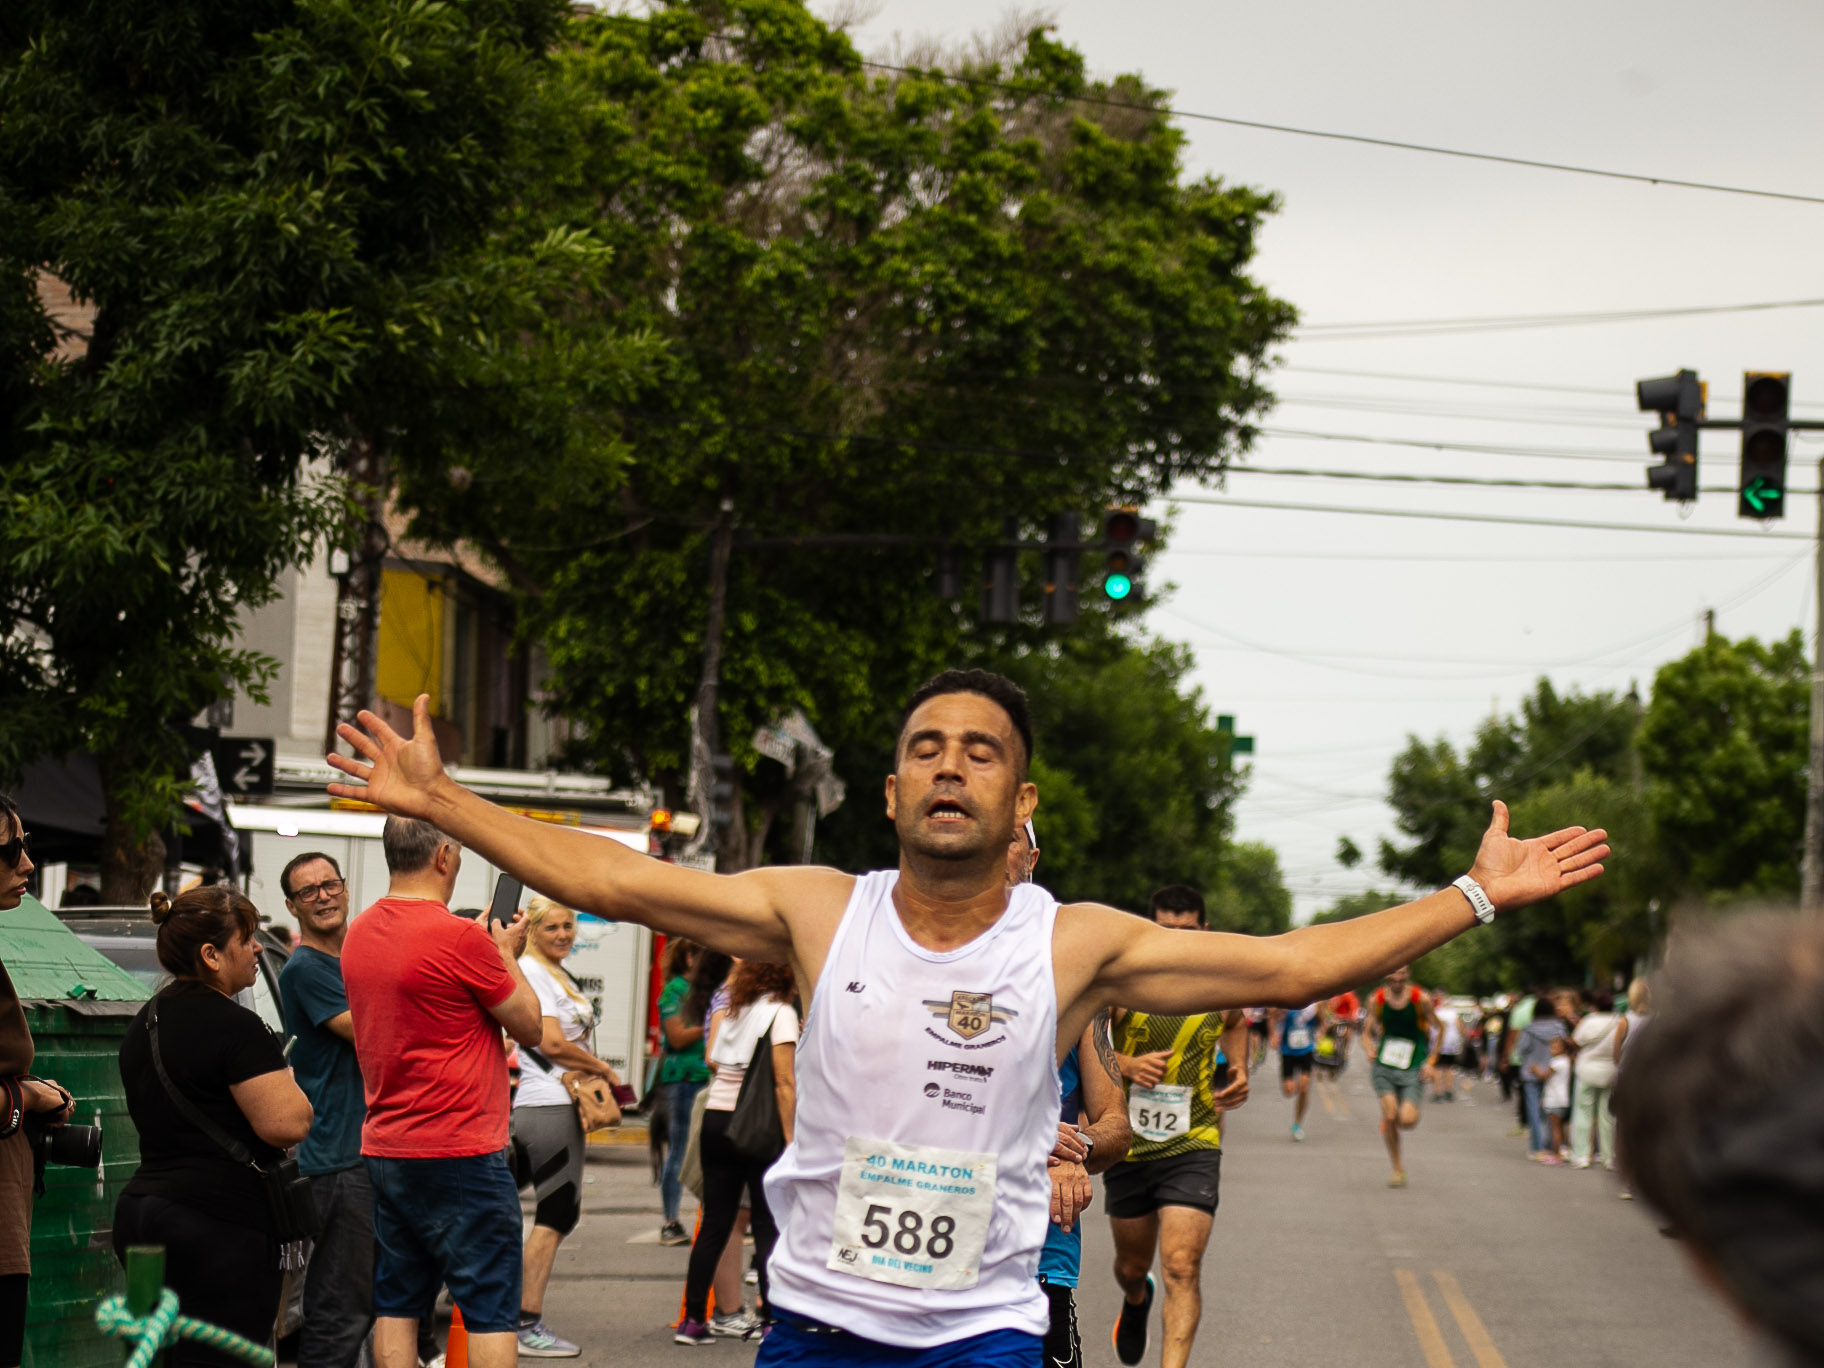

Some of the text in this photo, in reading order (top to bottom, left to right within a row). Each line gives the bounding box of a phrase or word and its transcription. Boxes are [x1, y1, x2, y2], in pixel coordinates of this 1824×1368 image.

[957, 1016, 982, 1030] 40
[925, 1027, 1007, 1050] EMPALME GRANEROS
[944, 1088, 972, 1101] Banco
[942, 1099, 986, 1115] Municipal
[1139, 1109, 1177, 1131] 512
[867, 1155, 973, 1179] 40 MARATON
[860, 1171, 976, 1195] EMPALME GRANEROS
[861, 1204, 955, 1259] 588
